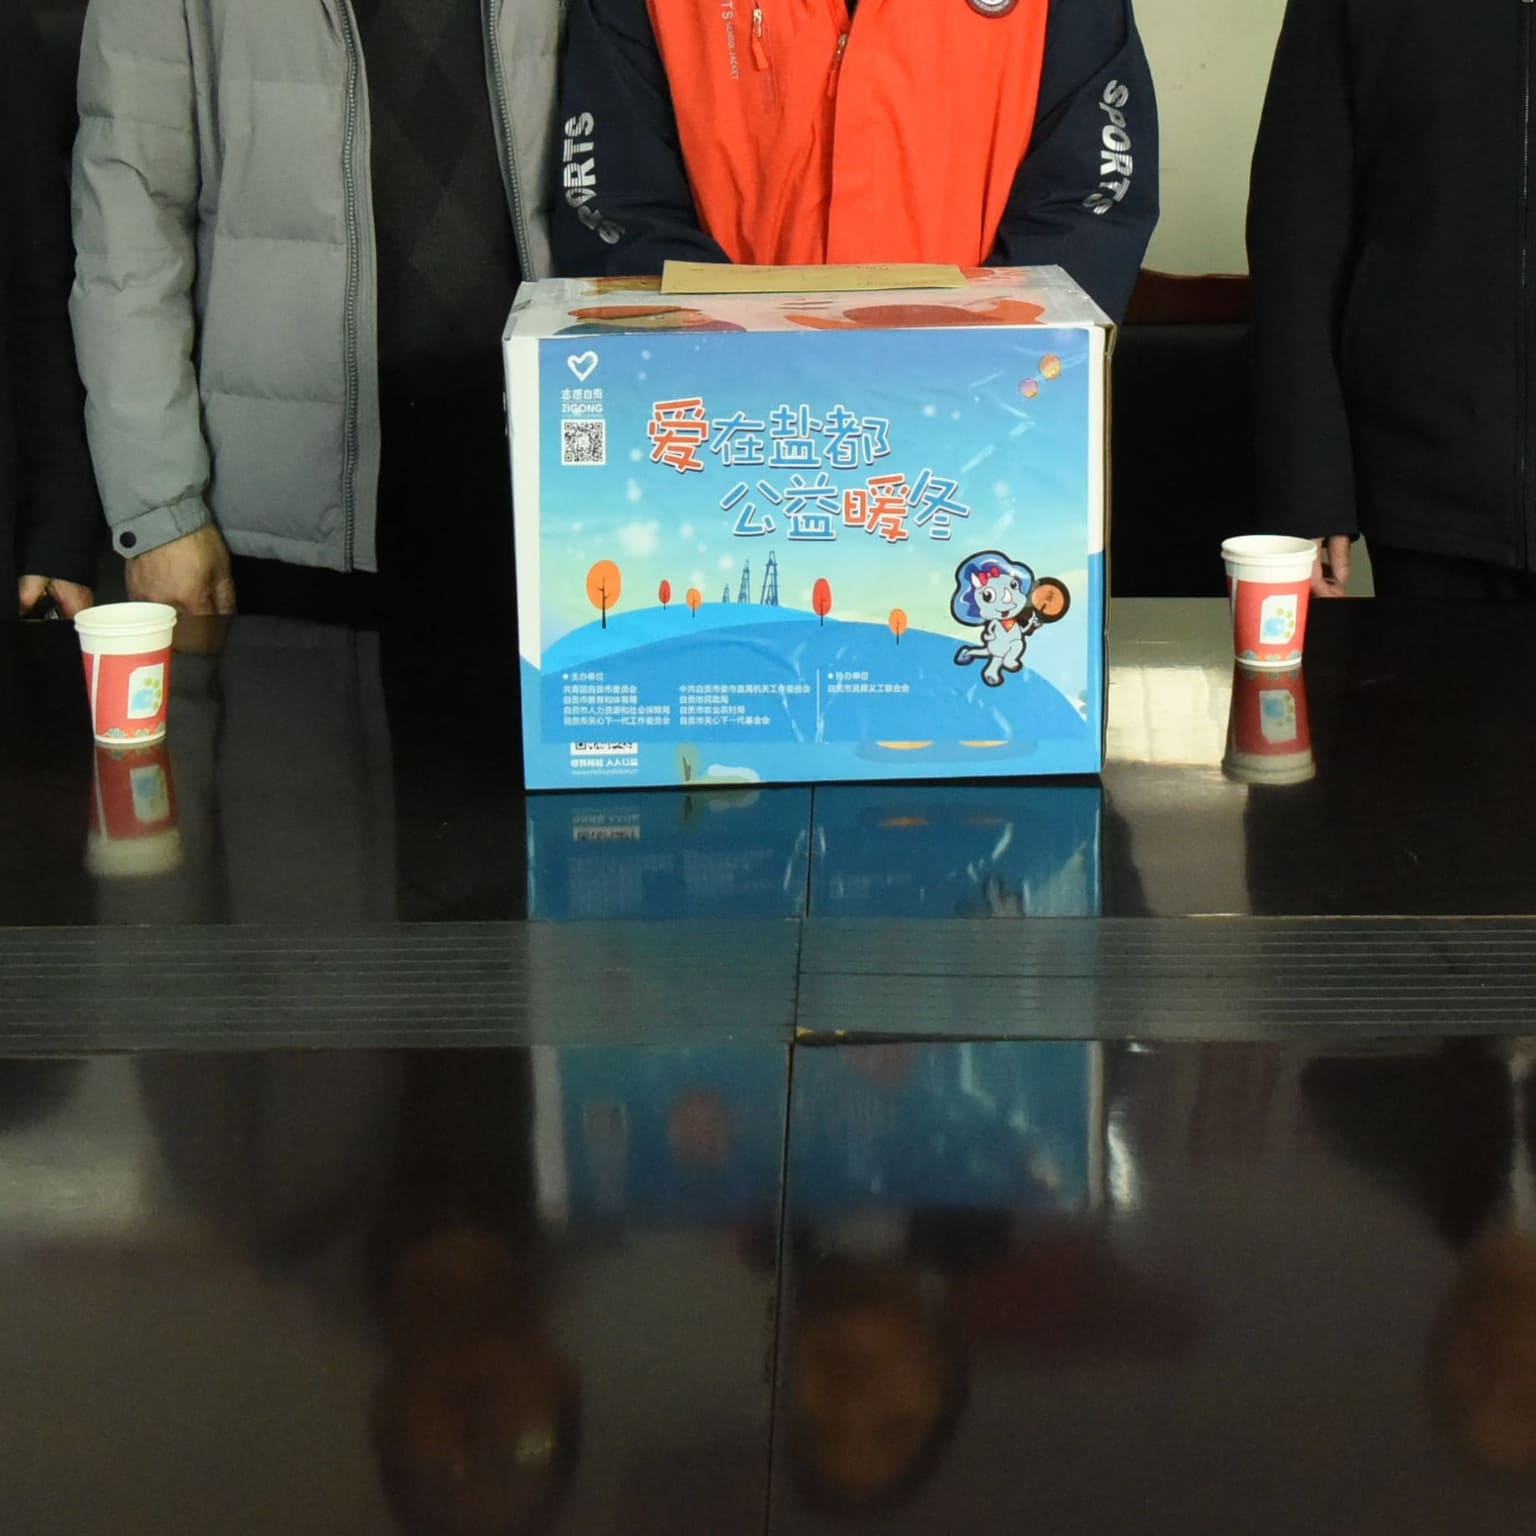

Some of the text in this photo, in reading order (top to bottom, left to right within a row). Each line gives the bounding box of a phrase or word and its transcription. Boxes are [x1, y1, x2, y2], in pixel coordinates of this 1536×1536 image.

[563, 111, 627, 246] SPORTS
[1083, 79, 1135, 216] SPORTS
[561, 402, 603, 414] ZIGONG
[646, 396, 890, 472] 爱在盐都
[720, 468, 970, 542] 公益暖冬
